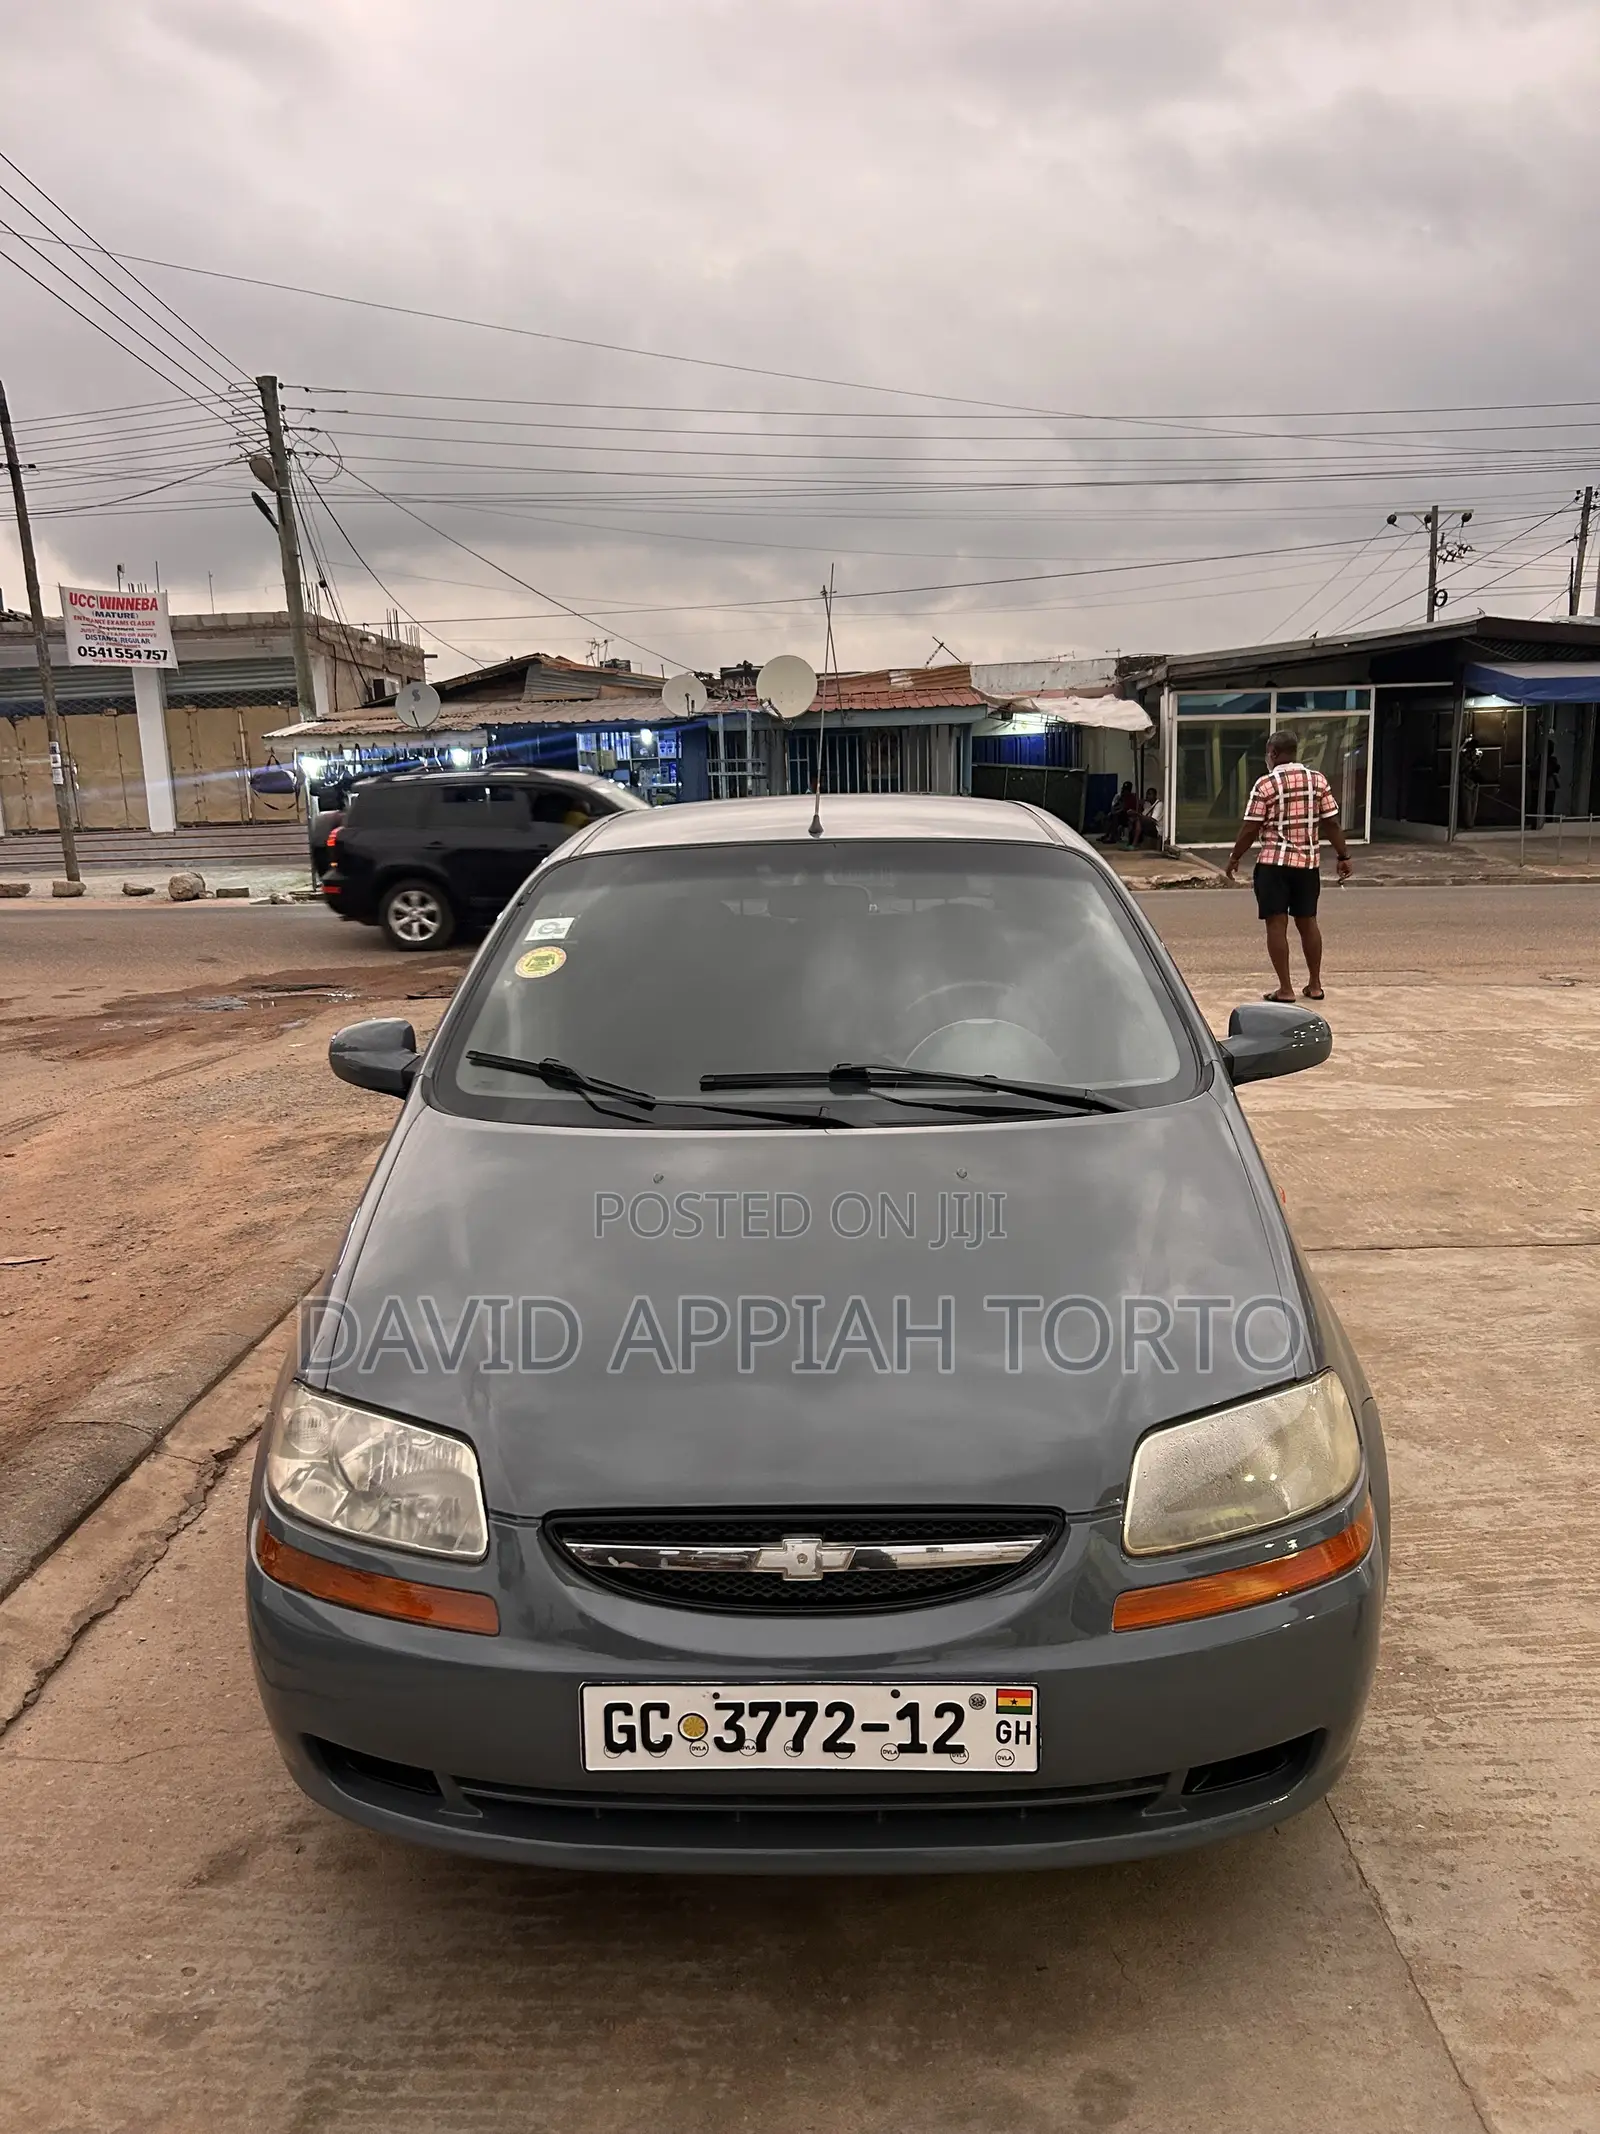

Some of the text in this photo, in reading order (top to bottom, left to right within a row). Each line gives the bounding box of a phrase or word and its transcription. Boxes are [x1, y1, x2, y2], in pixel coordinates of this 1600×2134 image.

[69, 592, 159, 611] UCC WINNEBA
[73, 615, 106, 625] ENTRANCE
[92, 610, 138, 619] (MATURE)
[603, 1701, 966, 1754] GC 3772-12
[996, 1719, 1031, 1745] GH
